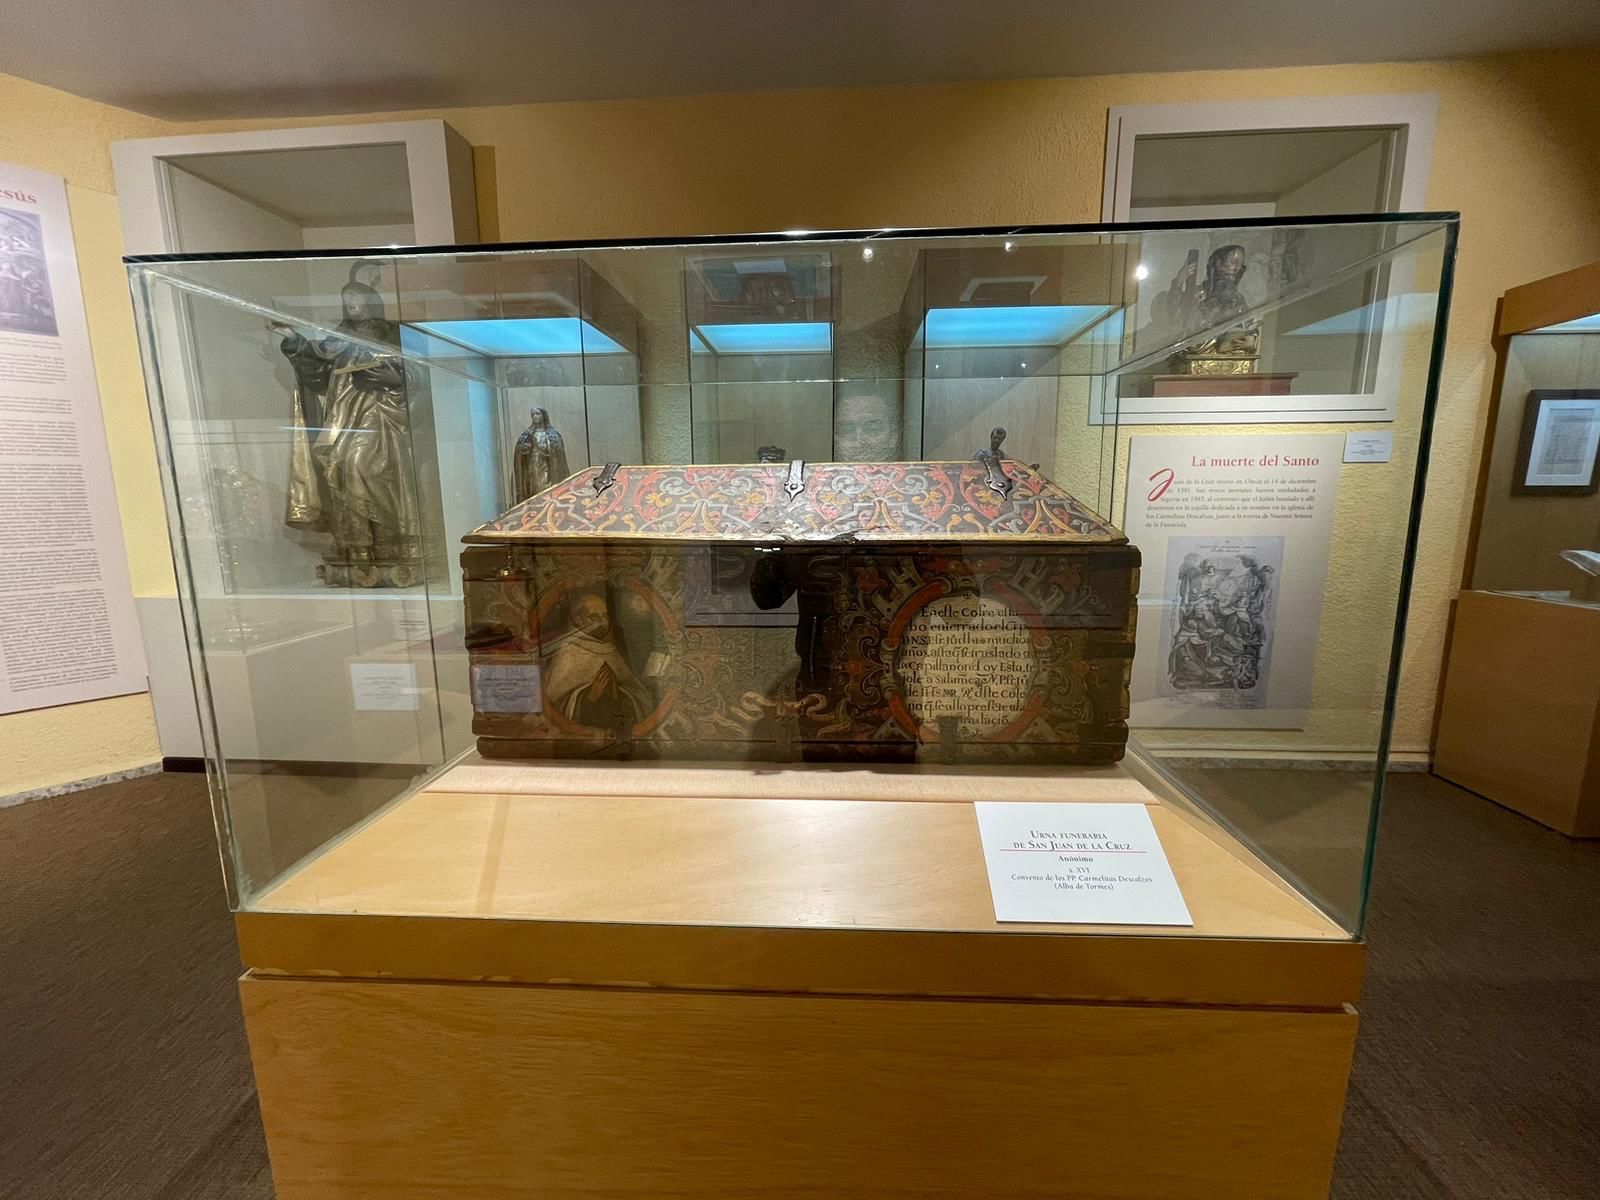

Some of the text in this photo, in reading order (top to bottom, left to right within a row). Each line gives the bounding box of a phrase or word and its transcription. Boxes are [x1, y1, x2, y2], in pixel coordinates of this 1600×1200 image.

[1191, 455, 1320, 467] La muerte del Santo
[1030, 829, 1108, 840] URNA FUNERARIA
[1013, 839, 1132, 851] DE SAN JUAN DE LA CRUZ
[1075, 866, 1090, 874] XVI
[1011, 873, 1044, 881] Convento
[1078, 875, 1117, 883] Carmelitas
[1118, 875, 1153, 883] Descalzos
[1054, 882, 1114, 891] (Alba de Tormes)
